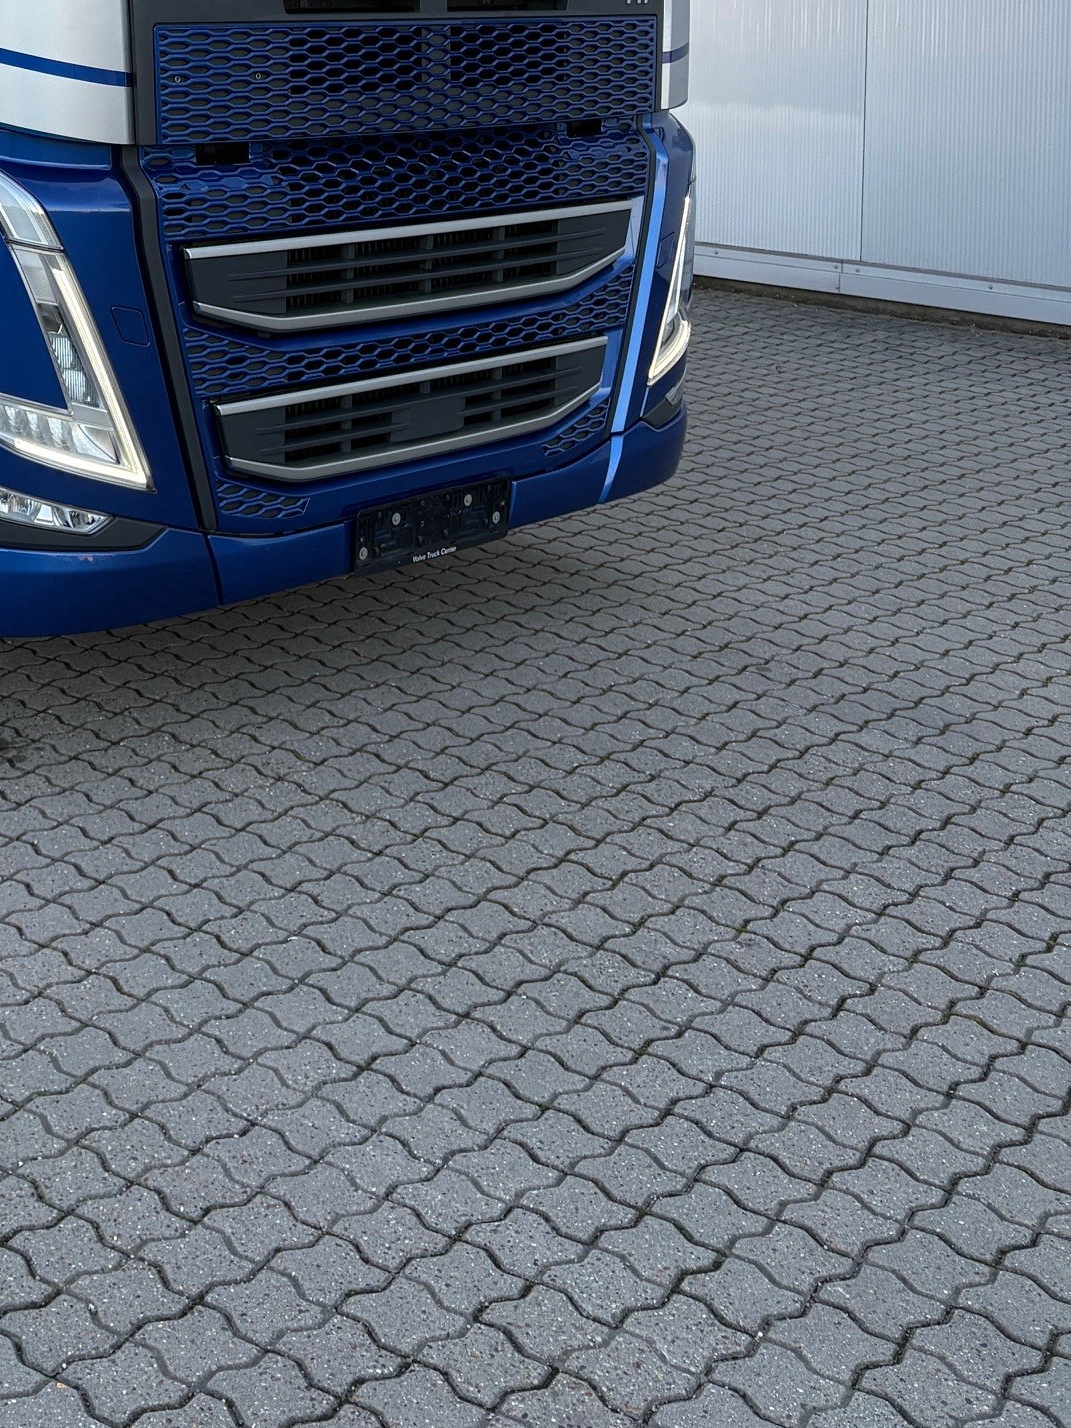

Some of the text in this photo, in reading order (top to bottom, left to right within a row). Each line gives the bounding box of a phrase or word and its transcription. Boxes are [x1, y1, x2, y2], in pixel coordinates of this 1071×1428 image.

[412, 546, 457, 563] Volvo Truck Center
